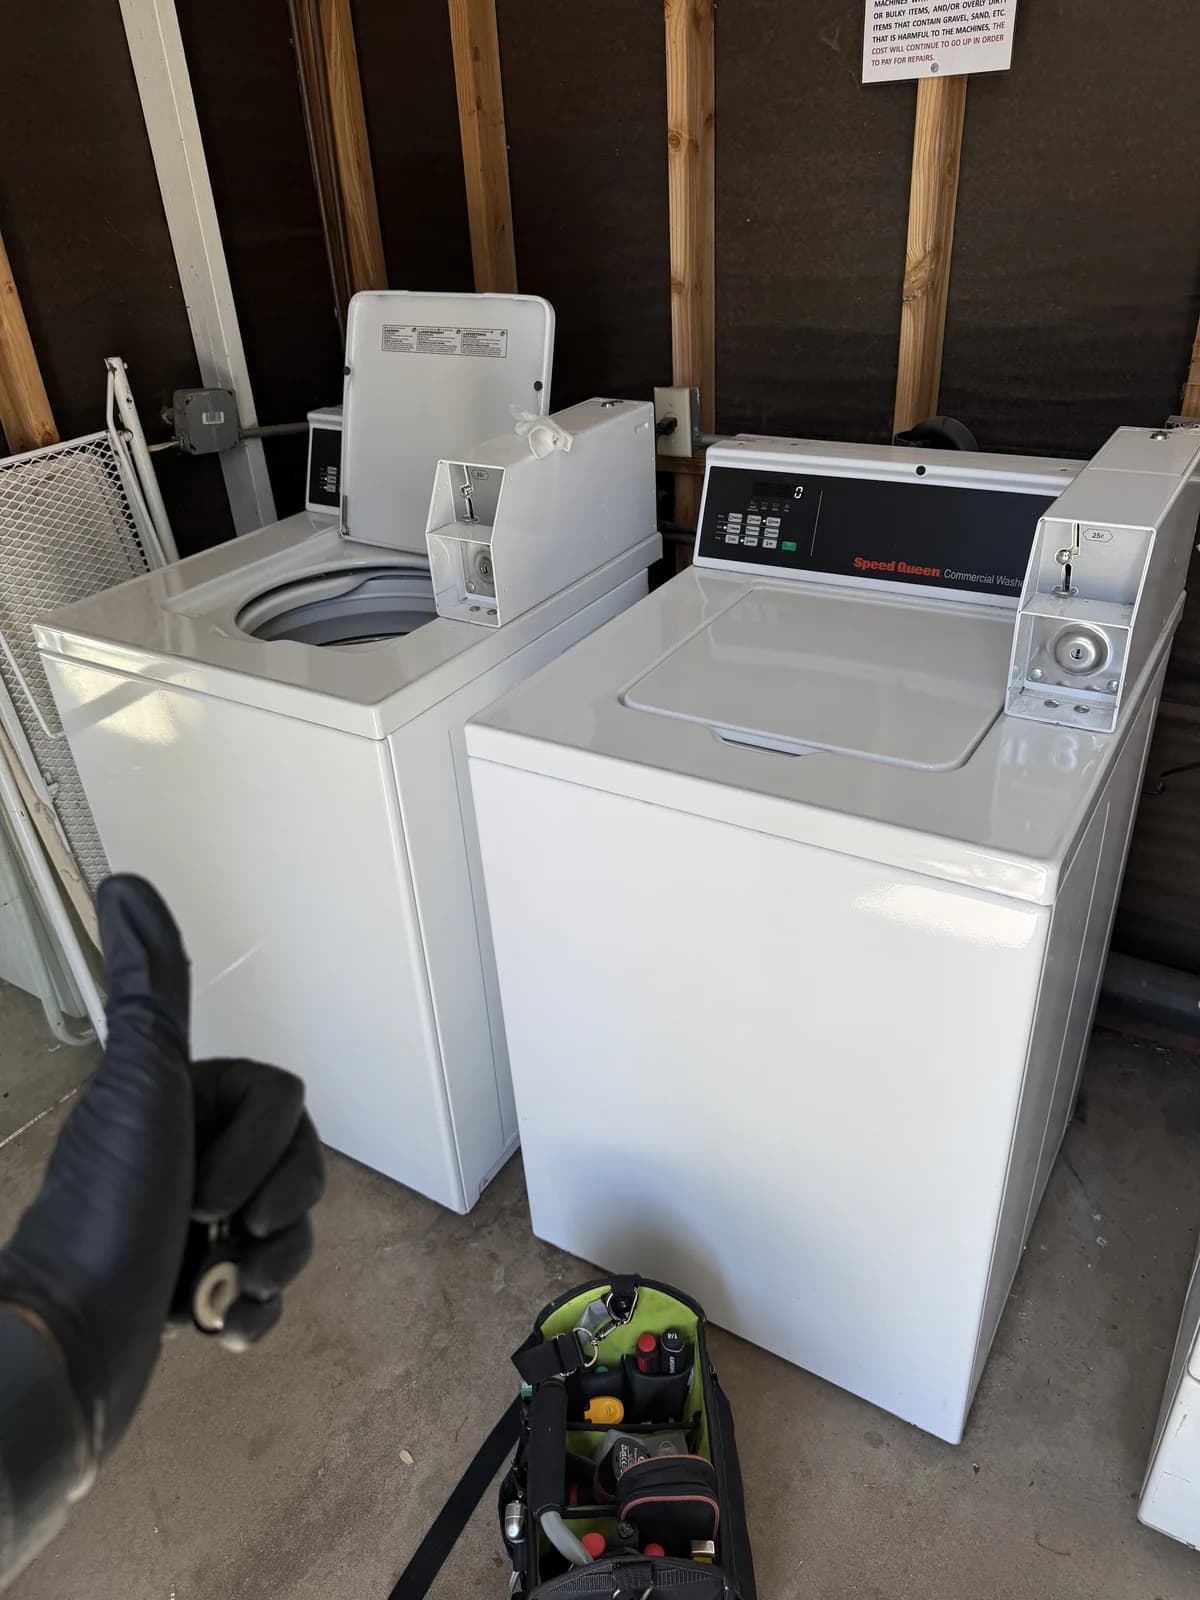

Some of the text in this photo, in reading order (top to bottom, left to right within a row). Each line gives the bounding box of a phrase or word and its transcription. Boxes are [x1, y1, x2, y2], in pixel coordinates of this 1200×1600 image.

[873, 8, 1006, 31] ITEMS THAT CONTAIN GRAVEL, SAND, ETC.
[885, 9, 906, 18] BULKY
[909, 6, 930, 15] ITEMS,
[933, 2, 960, 12] AND/OR
[962, 0, 986, 9] OVERLY
[872, 21, 1006, 43] THAT IS HARMFUL TO THE MACHINES, THE
[871, 34, 1004, 55] COST WILL CONTINUE TO GO UP IN ORDER
[872, 59, 880, 67] TO
[893, 56, 906, 64] FOR
[908, 54, 935, 64] REPAIRS.
[794, 486, 804, 499] 0
[853, 556, 897, 572] Speed
[897, 561, 941, 578] Queen
[943, 568, 995, 585] Commercial
